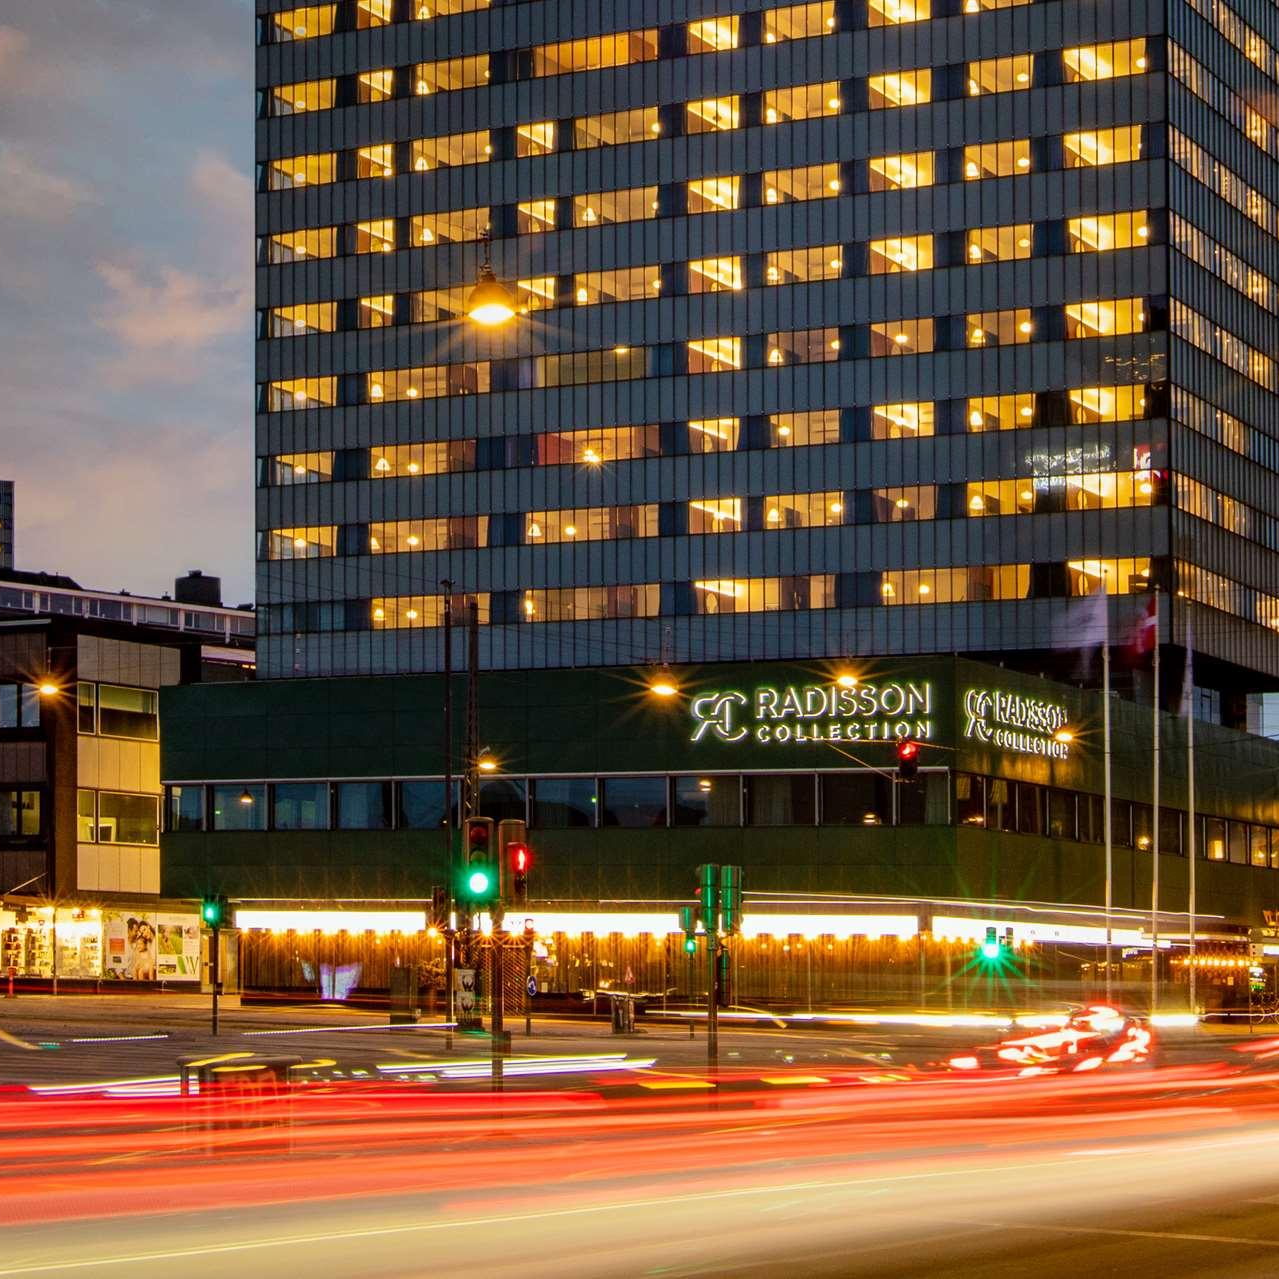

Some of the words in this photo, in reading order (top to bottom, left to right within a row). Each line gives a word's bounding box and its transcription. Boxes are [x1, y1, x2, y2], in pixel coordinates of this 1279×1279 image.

[755, 682, 933, 719] RADISSON
[995, 691, 1069, 734] RADISSON
[757, 721, 932, 743] COLLECTION
[994, 732, 1069, 760] COLLECTION
